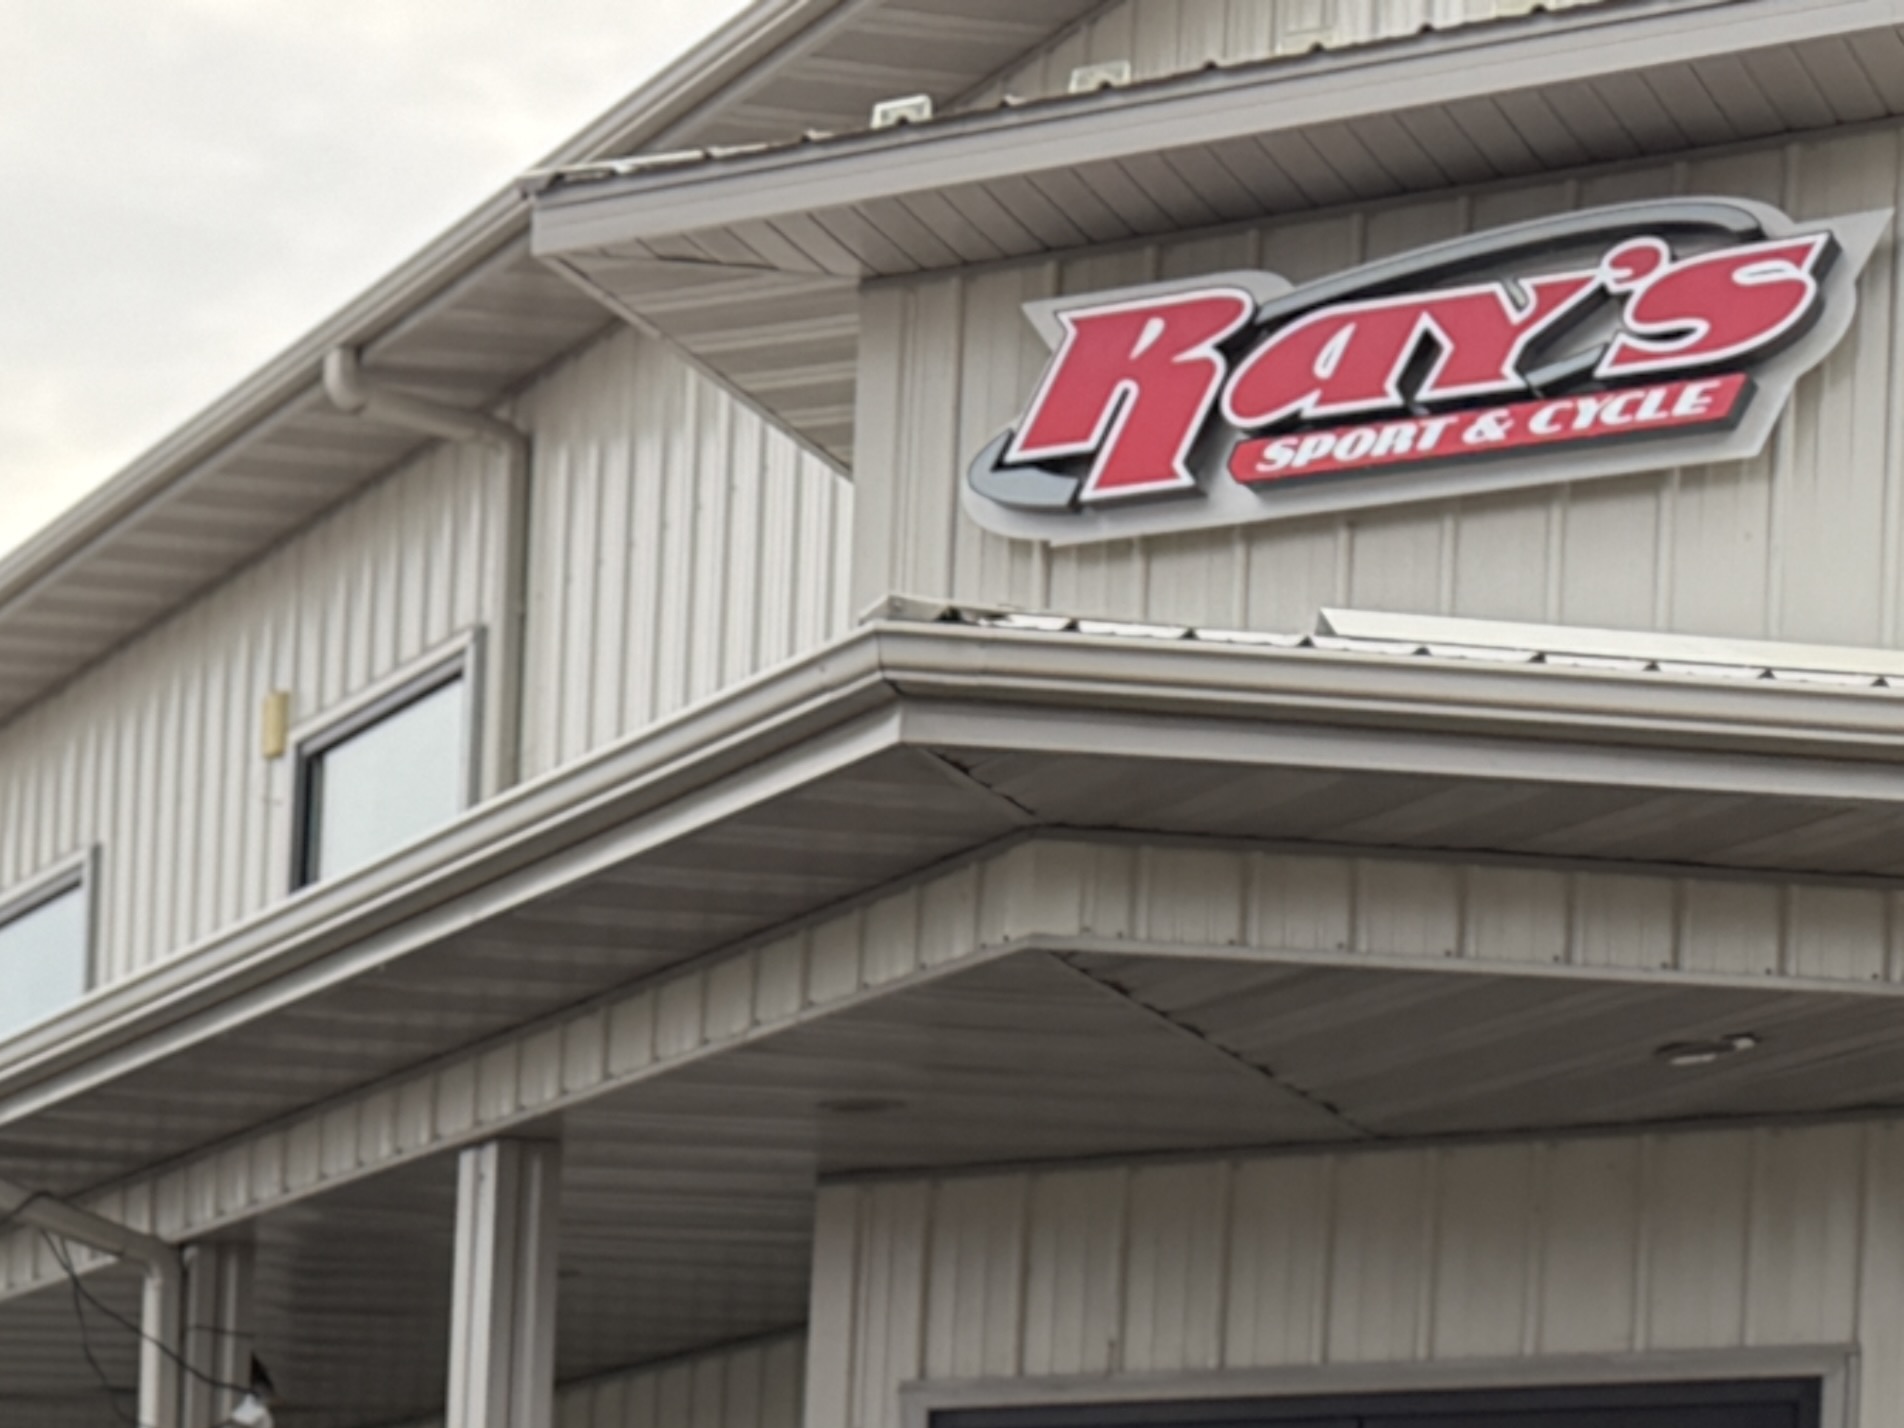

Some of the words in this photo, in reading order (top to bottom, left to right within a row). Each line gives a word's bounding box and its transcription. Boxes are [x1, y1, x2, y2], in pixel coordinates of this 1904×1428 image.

[1254, 415, 1455, 472] SPORT
[1463, 408, 1513, 444] &
[1528, 381, 1718, 436] CYCLE
